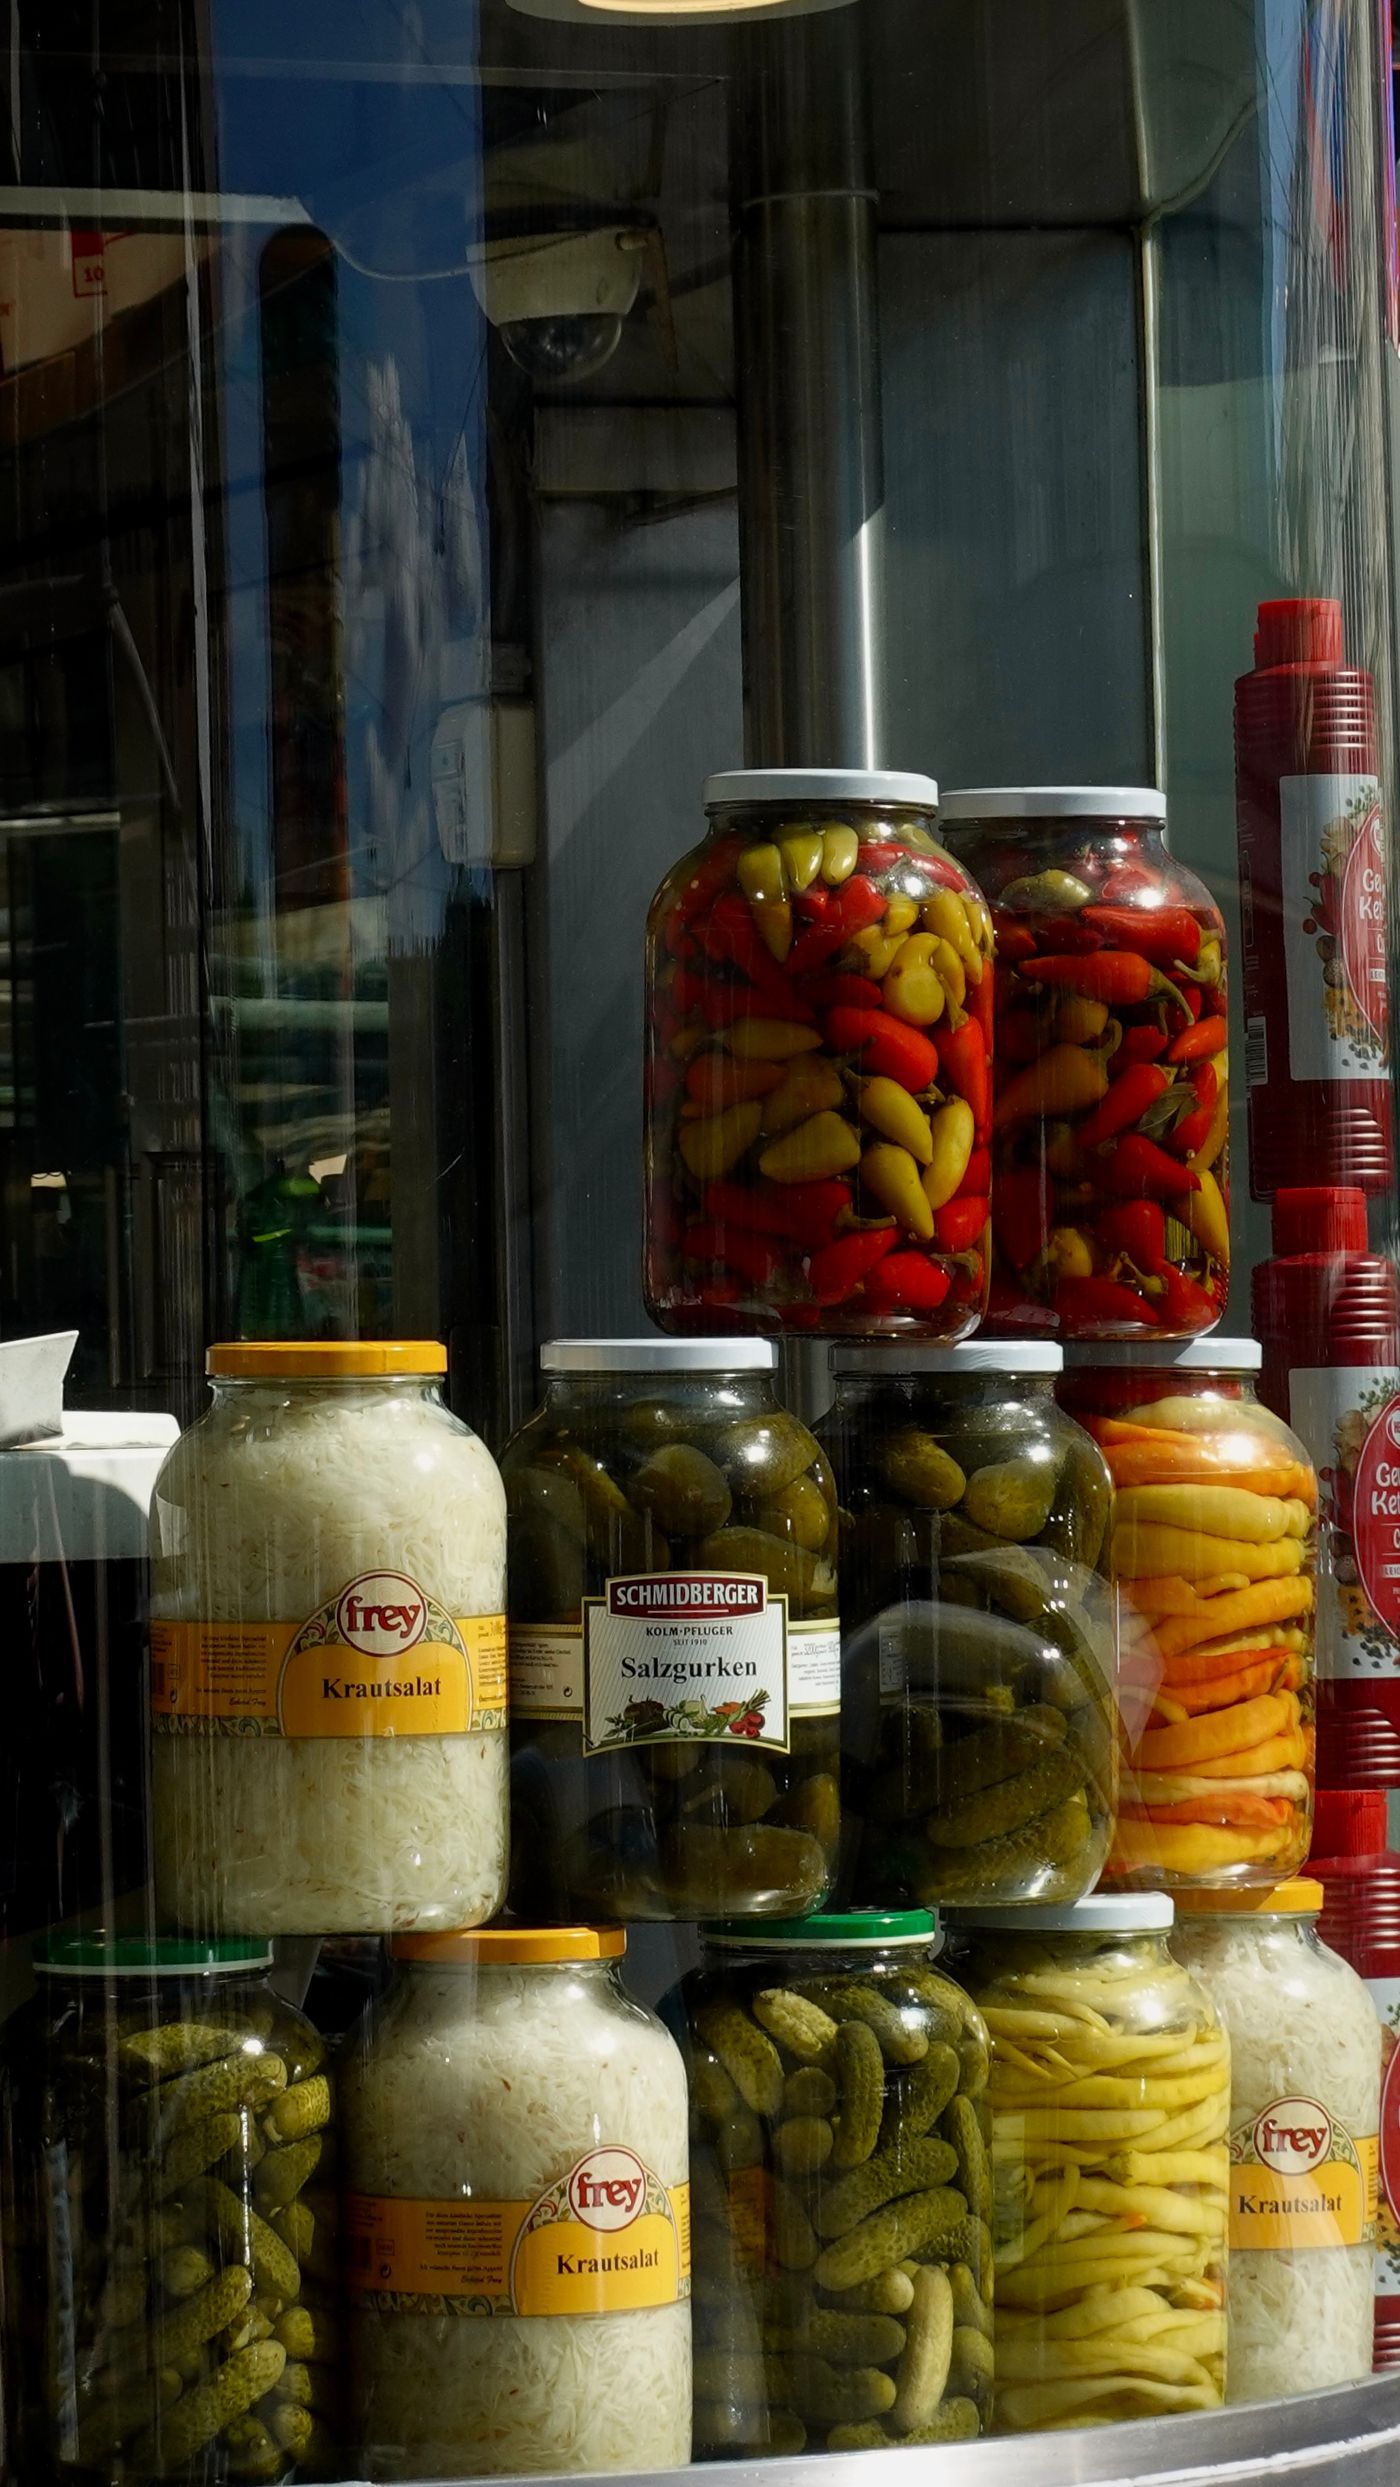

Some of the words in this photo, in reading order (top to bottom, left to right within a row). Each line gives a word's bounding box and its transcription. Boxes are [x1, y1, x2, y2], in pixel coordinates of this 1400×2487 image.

[616, 1582, 759, 1606] SCHMIDBERGER
[346, 1595, 421, 1638] frey
[621, 1656, 757, 1684] Salzgurken
[322, 1677, 442, 1699] Krautsalat
[1262, 2120, 1328, 2159] frey
[577, 2173, 642, 2213] frey
[1239, 2193, 1342, 2215] Krautsalat
[557, 2248, 659, 2275] Krautsalat
